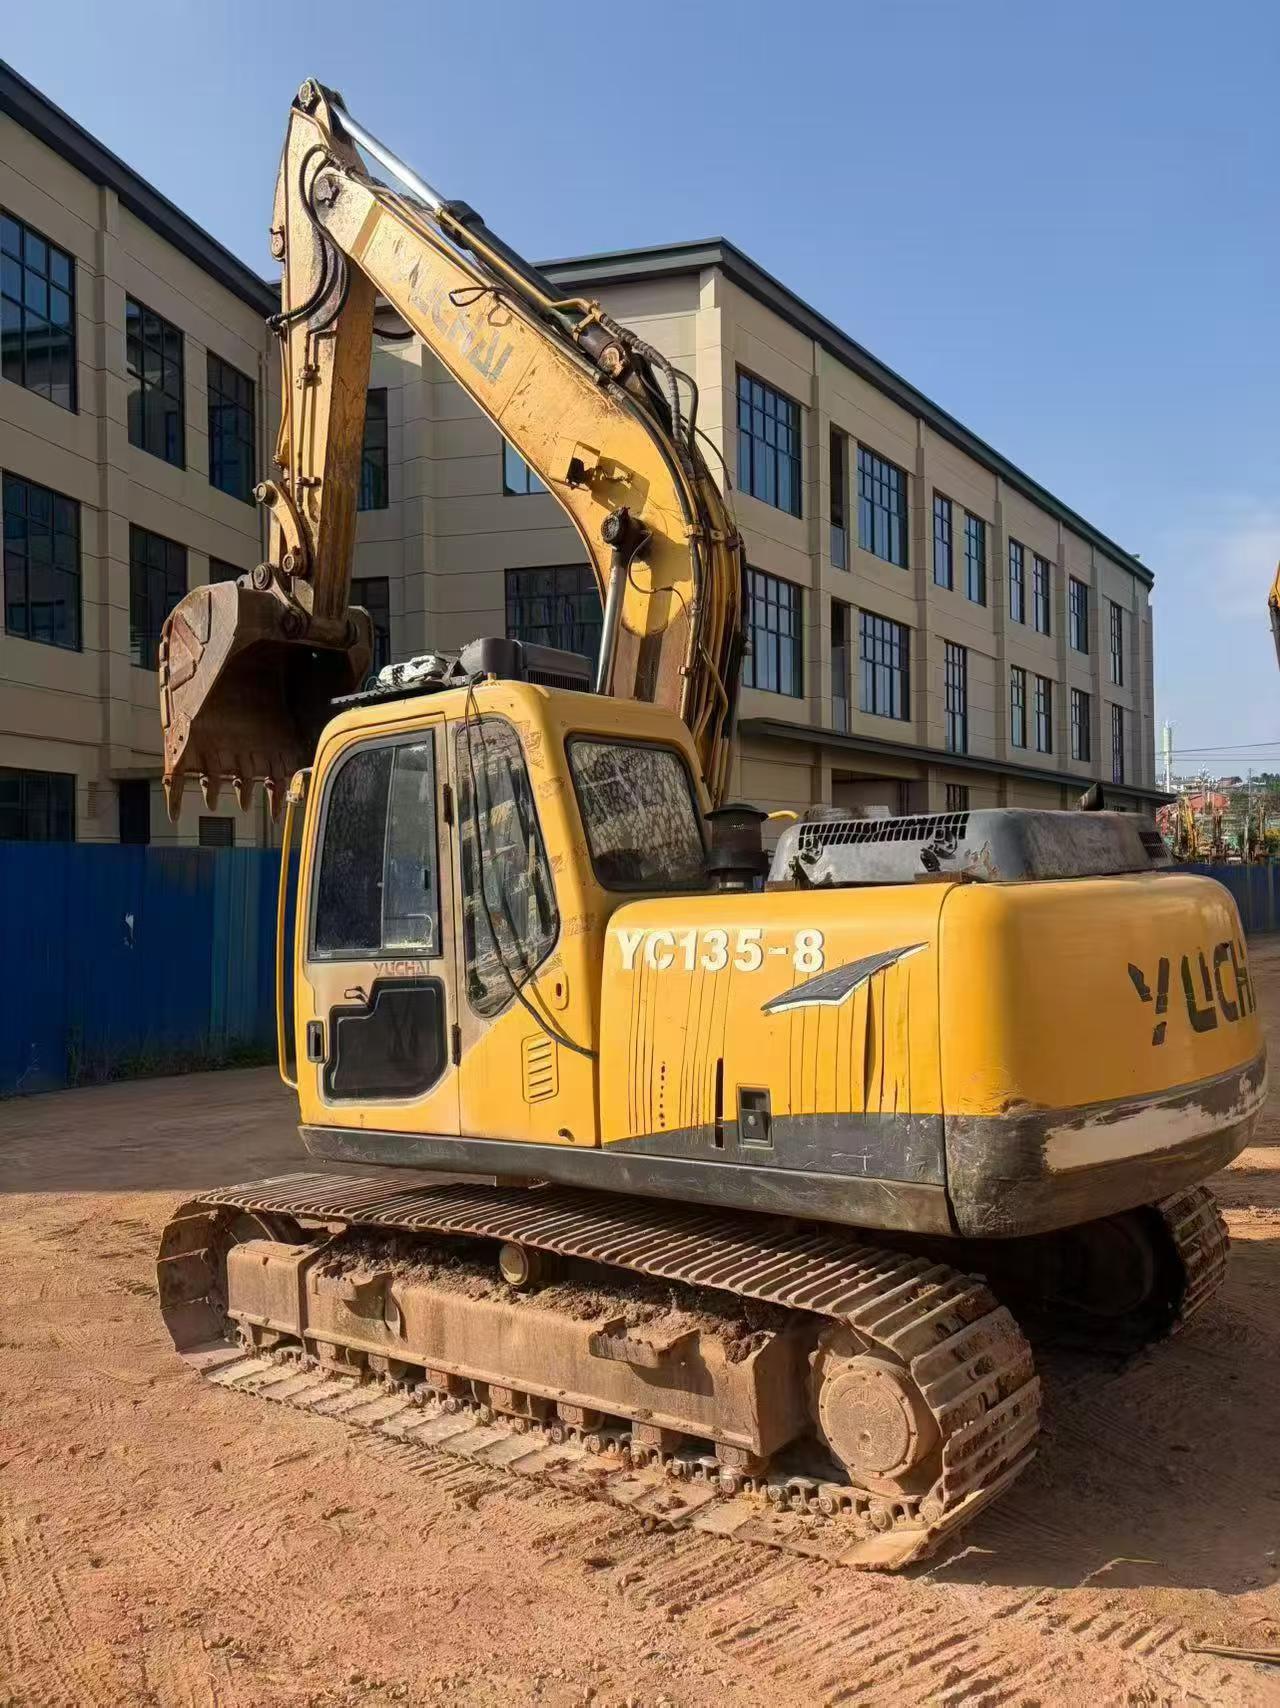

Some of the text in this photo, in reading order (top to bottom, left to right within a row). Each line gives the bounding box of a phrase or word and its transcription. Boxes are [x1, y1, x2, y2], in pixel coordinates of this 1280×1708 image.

[392, 237, 514, 385] UCHAI
[372, 960, 430, 976] YUCHAI
[616, 928, 825, 972] YC135-8
[1127, 938, 1256, 1046] YUCH
